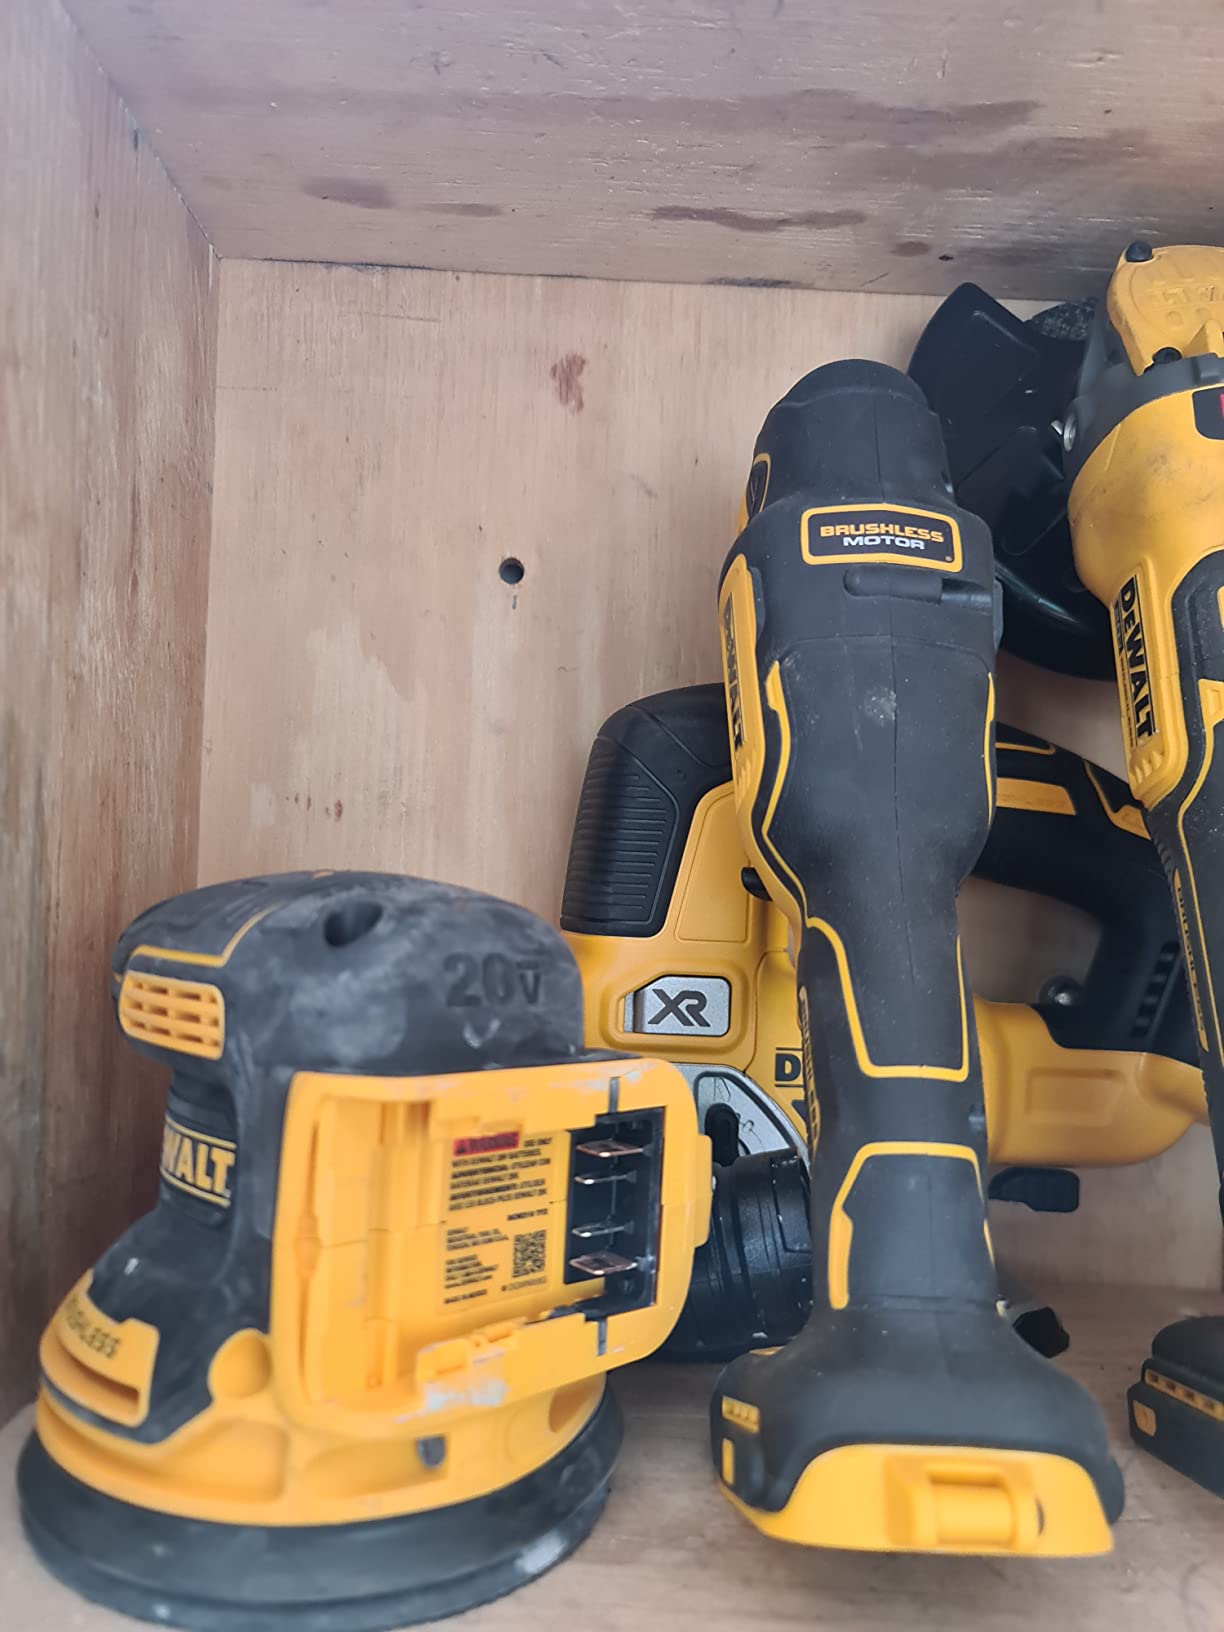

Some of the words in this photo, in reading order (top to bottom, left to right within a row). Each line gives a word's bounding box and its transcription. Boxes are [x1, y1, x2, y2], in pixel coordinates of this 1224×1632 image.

[820, 523, 944, 543] BRUSHLESS
[843, 535, 925, 550] MOTOR
[648, 988, 711, 1028] XR
